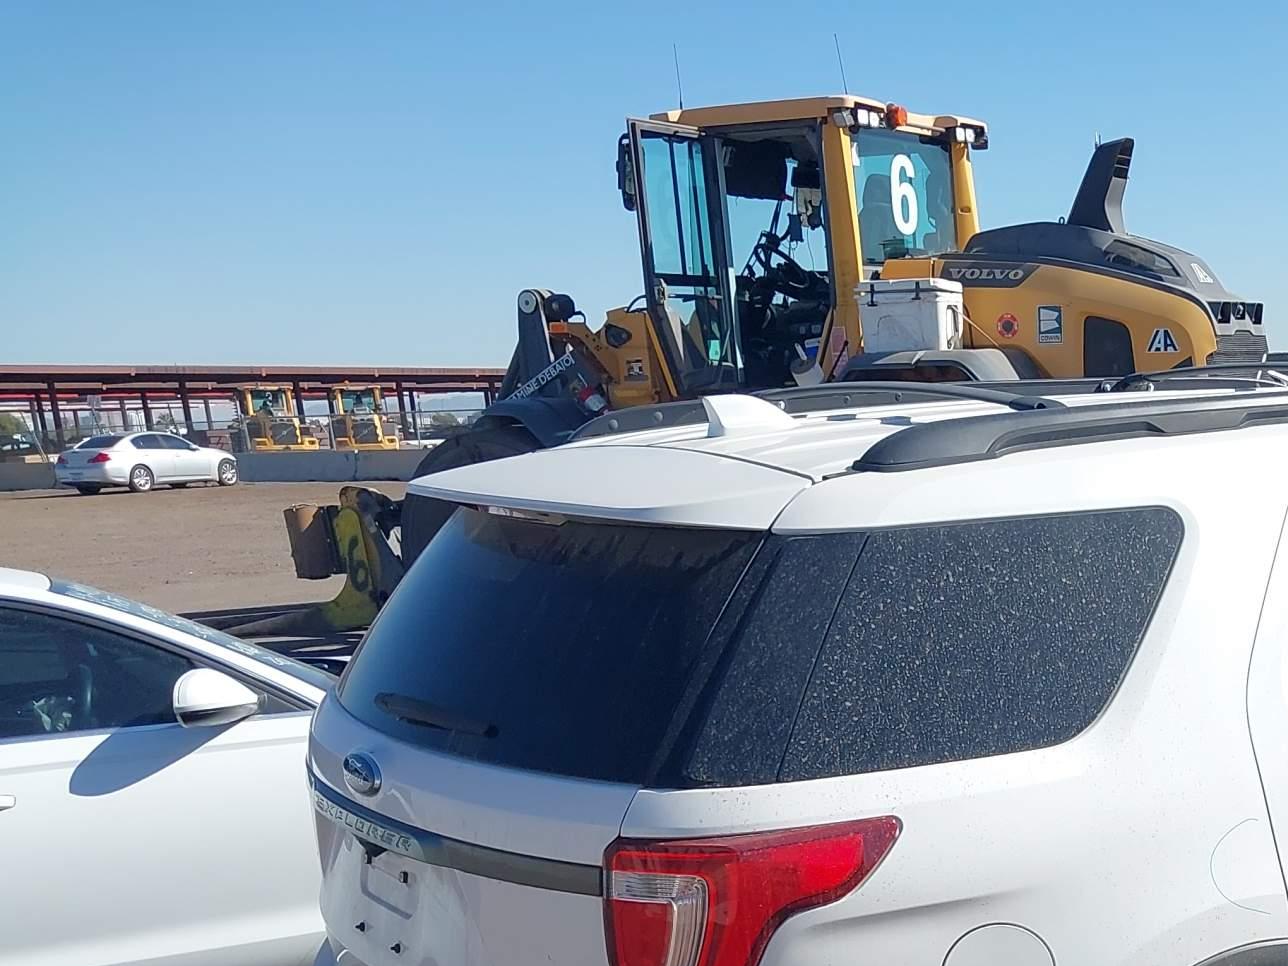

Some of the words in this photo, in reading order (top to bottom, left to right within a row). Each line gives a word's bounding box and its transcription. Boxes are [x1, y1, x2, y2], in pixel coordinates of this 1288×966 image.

[890, 153, 918, 236] 6
[948, 267, 1024, 280] VOLVO
[315, 796, 412, 852] EXPLORER
